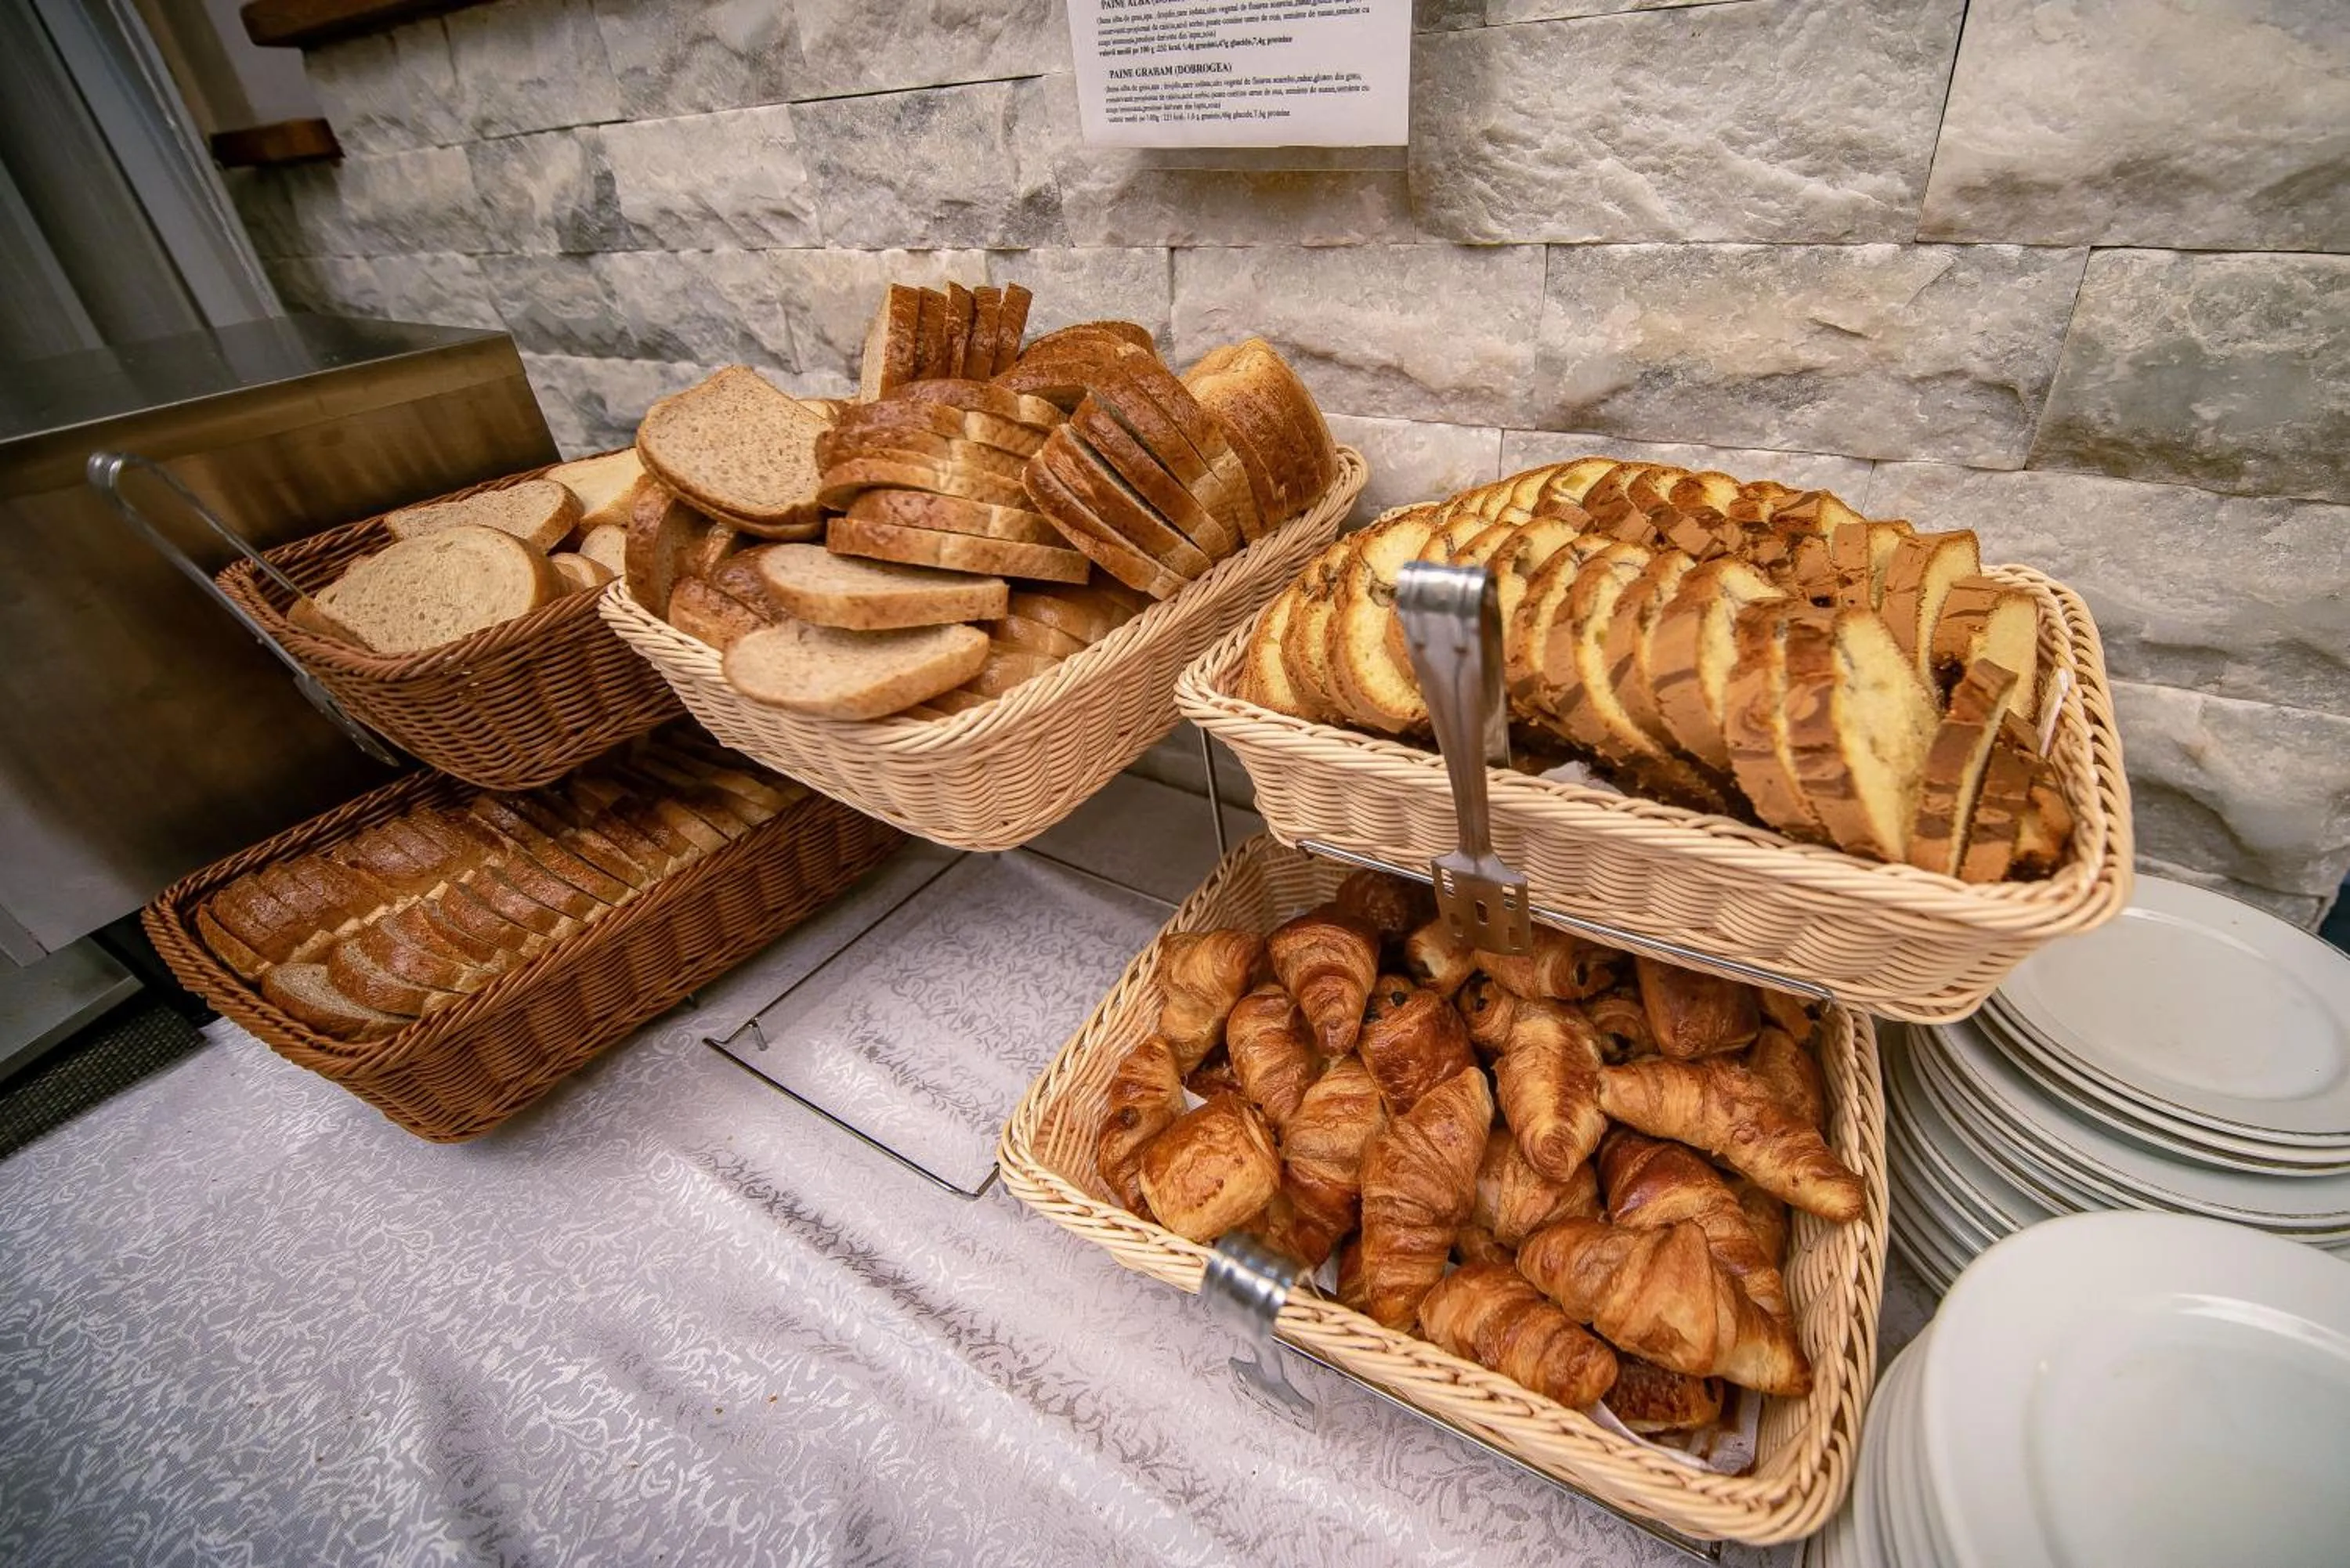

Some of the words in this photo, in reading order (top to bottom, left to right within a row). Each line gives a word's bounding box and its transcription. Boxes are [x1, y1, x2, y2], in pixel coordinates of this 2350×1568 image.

[1101, 0, 1124, 9] PAINE
[1109, 69, 1133, 79] PAINE
[1135, 65, 1173, 78] GRAHAM
[1175, 62, 1232, 77] (DOBROGEA)
